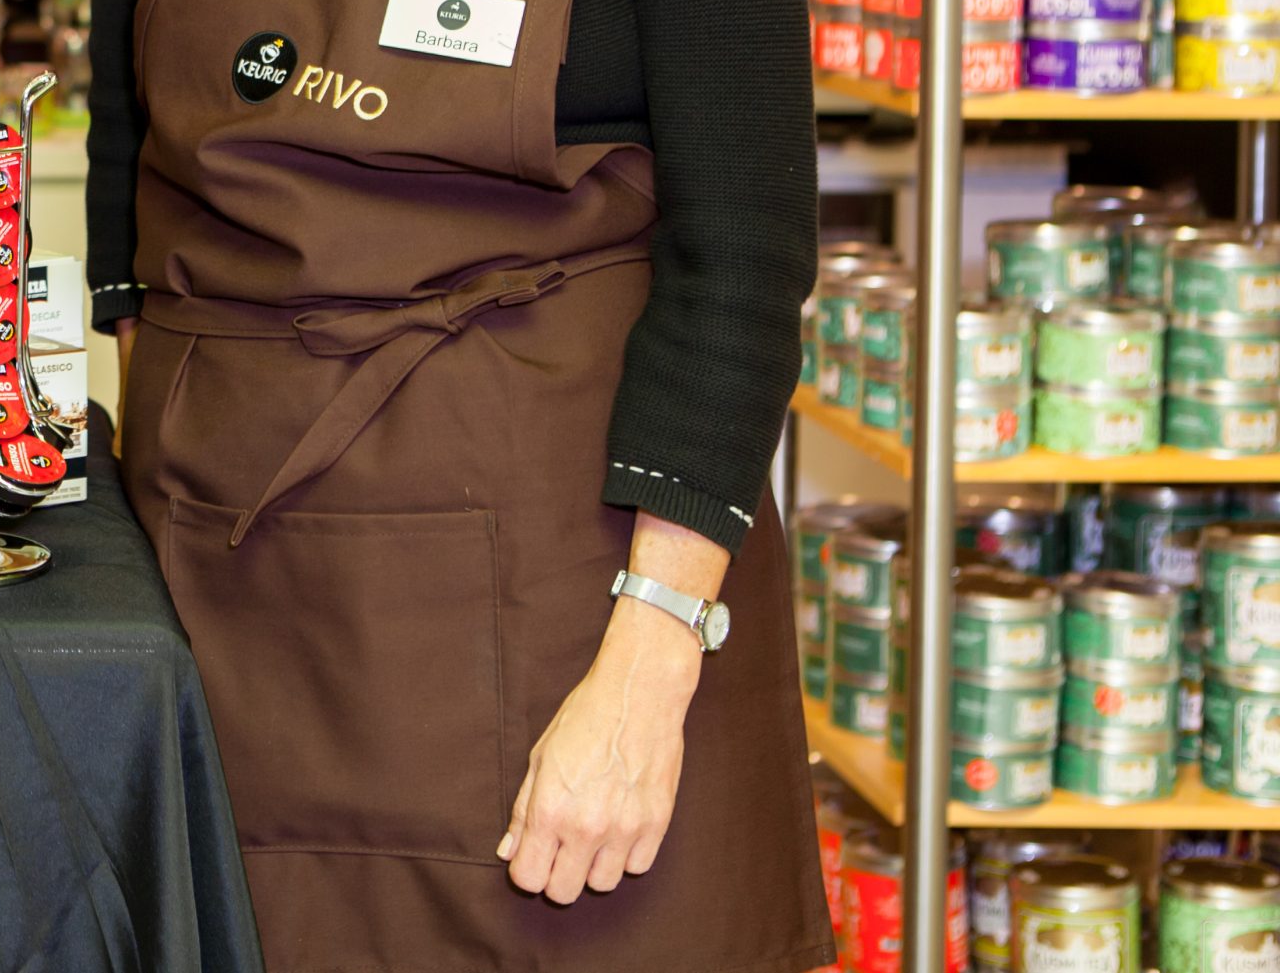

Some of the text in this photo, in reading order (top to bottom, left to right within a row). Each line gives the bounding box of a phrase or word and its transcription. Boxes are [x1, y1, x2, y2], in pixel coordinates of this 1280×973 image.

[440, 11, 468, 21] KEURIG
[415, 30, 479, 53] Barbara
[237, 58, 287, 85] KEURIG
[293, 64, 388, 120] RIVO
[31, 311, 61, 323] DECAF
[33, 362, 73, 375] CLASSICO
